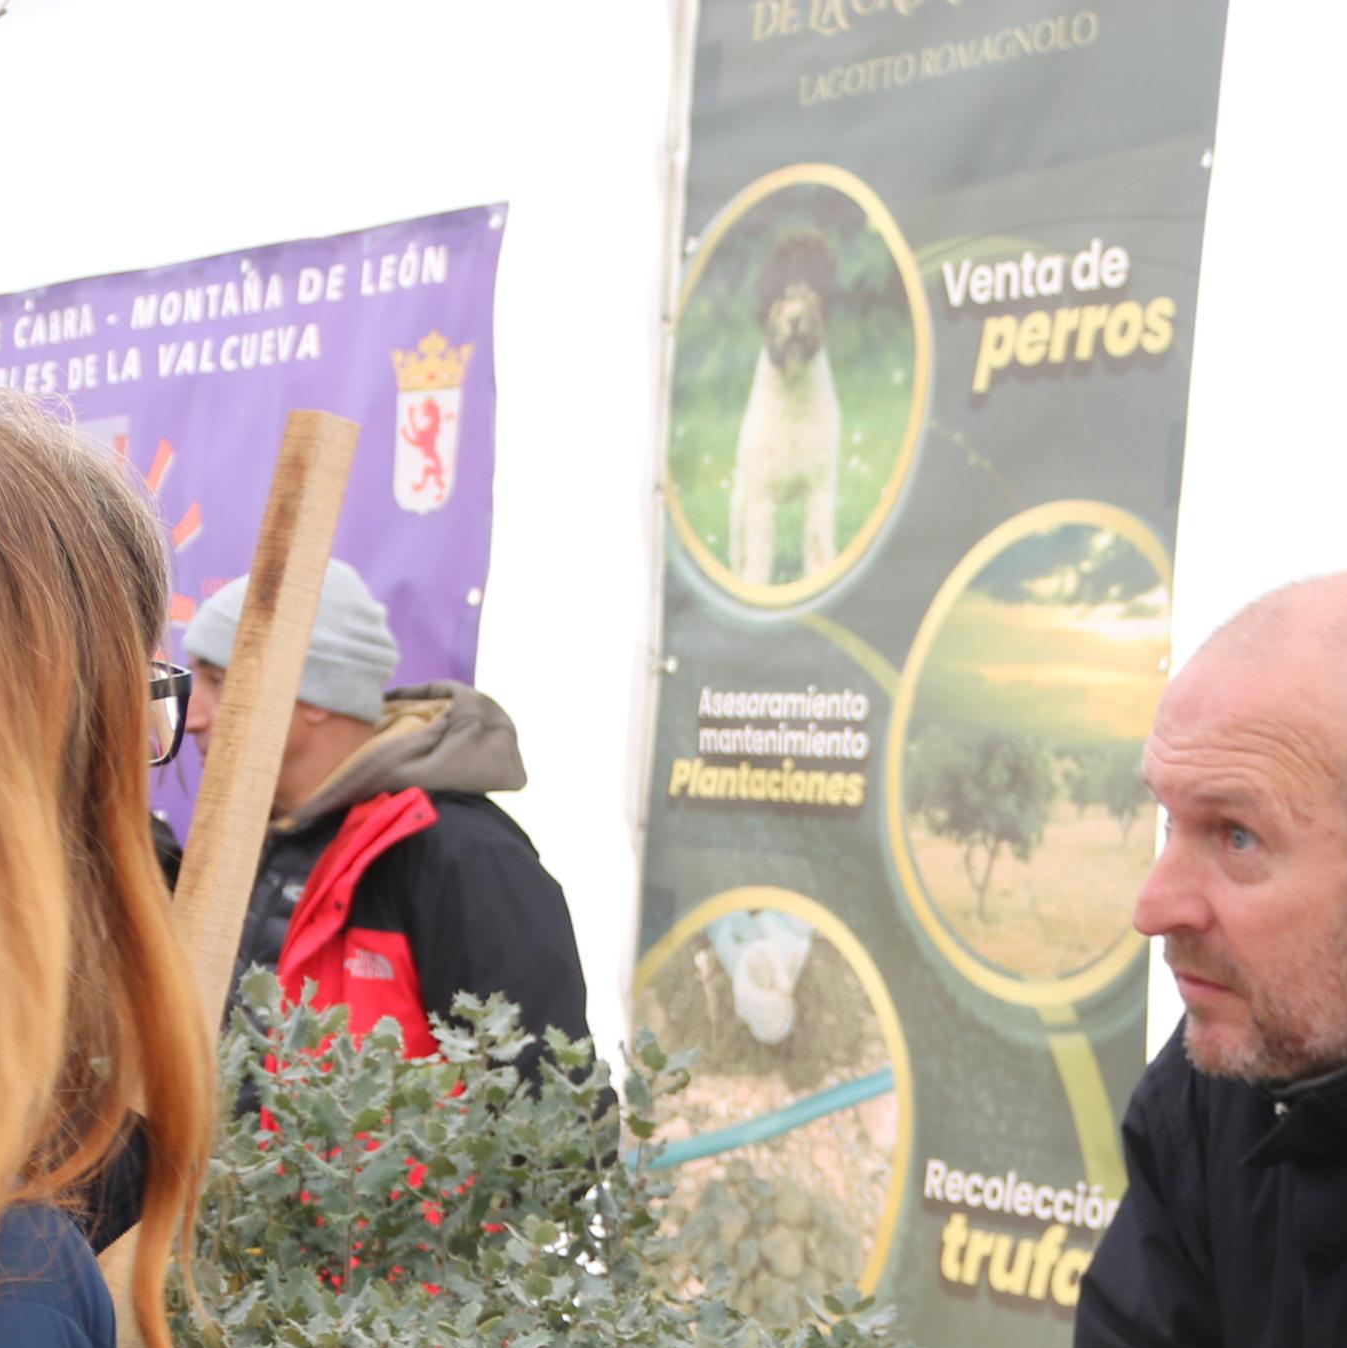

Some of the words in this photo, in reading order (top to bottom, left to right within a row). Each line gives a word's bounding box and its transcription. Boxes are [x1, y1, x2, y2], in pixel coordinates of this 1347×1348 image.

[799, 54, 915, 107] LAGOTTO
[919, 10, 1100, 80] ROMAGNOLO
[12, 303, 96, 350] CABRA
[296, 263, 348, 305] DE
[360, 241, 450, 297] LEÓN
[942, 247, 1062, 307] Venta
[1070, 238, 1131, 291] de
[66, 353, 99, 392] DE
[105, 346, 142, 385] LA
[157, 322, 322, 379] VALCUEVA
[972, 296, 1176, 394] perros
[698, 685, 870, 721] Asesoramiento
[698, 722, 870, 760] mantenimiento
[668, 757, 866, 807] Plantaciones
